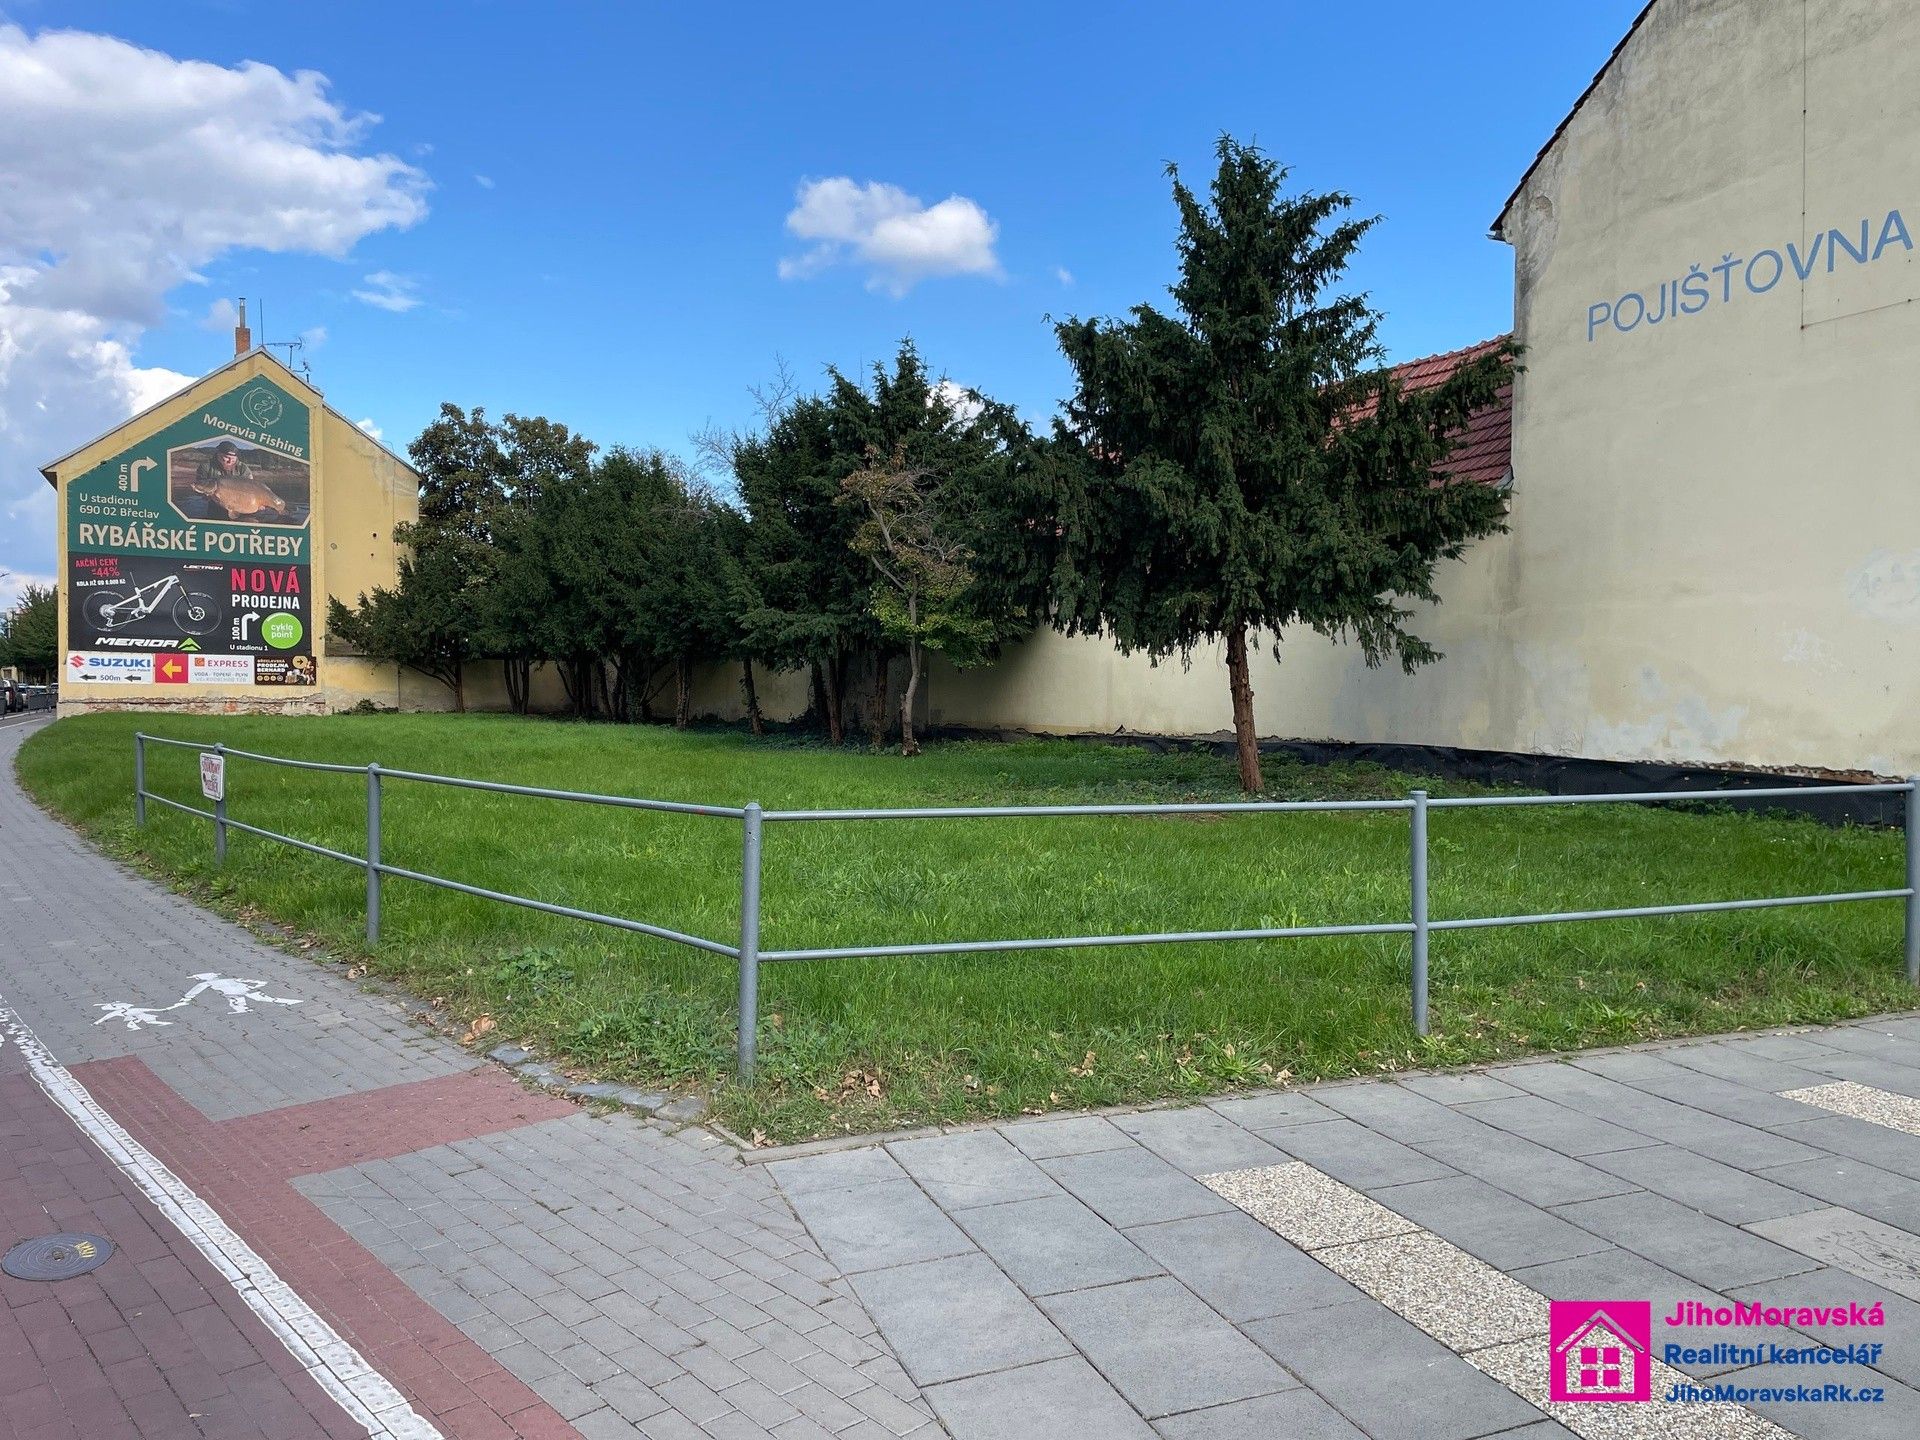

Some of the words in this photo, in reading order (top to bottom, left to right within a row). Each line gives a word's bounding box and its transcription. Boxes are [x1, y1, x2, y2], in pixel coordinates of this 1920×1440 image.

[1587, 209, 1914, 342] POJIŠŤOVNA
[203, 413, 257, 440] Moravia
[259, 433, 304, 457] Fishing
[120, 464, 128, 472] m
[118, 474, 128, 492] 400
[80, 492, 88, 502] U
[91, 495, 138, 506] stadionu
[79, 505, 100, 515] 690
[103, 506, 117, 516] 02
[120, 508, 160, 519] Břeclav
[79, 522, 198, 551] RYBÁŘSKÉ
[204, 528, 304, 557] POTŘEBY
[76, 558, 98, 568] AKČNÍ
[100, 558, 118, 567] CENY
[231, 566, 300, 594] NOVÁ
[231, 594, 300, 610] PRODEJNA
[233, 618, 240, 626] m
[270, 622, 294, 632] cyklo
[231, 626, 240, 640] 100
[272, 630, 293, 638] point
[95, 637, 180, 648] MERIDA
[88, 657, 151, 668] SUZUKI
[207, 660, 249, 668] EXPRESS
